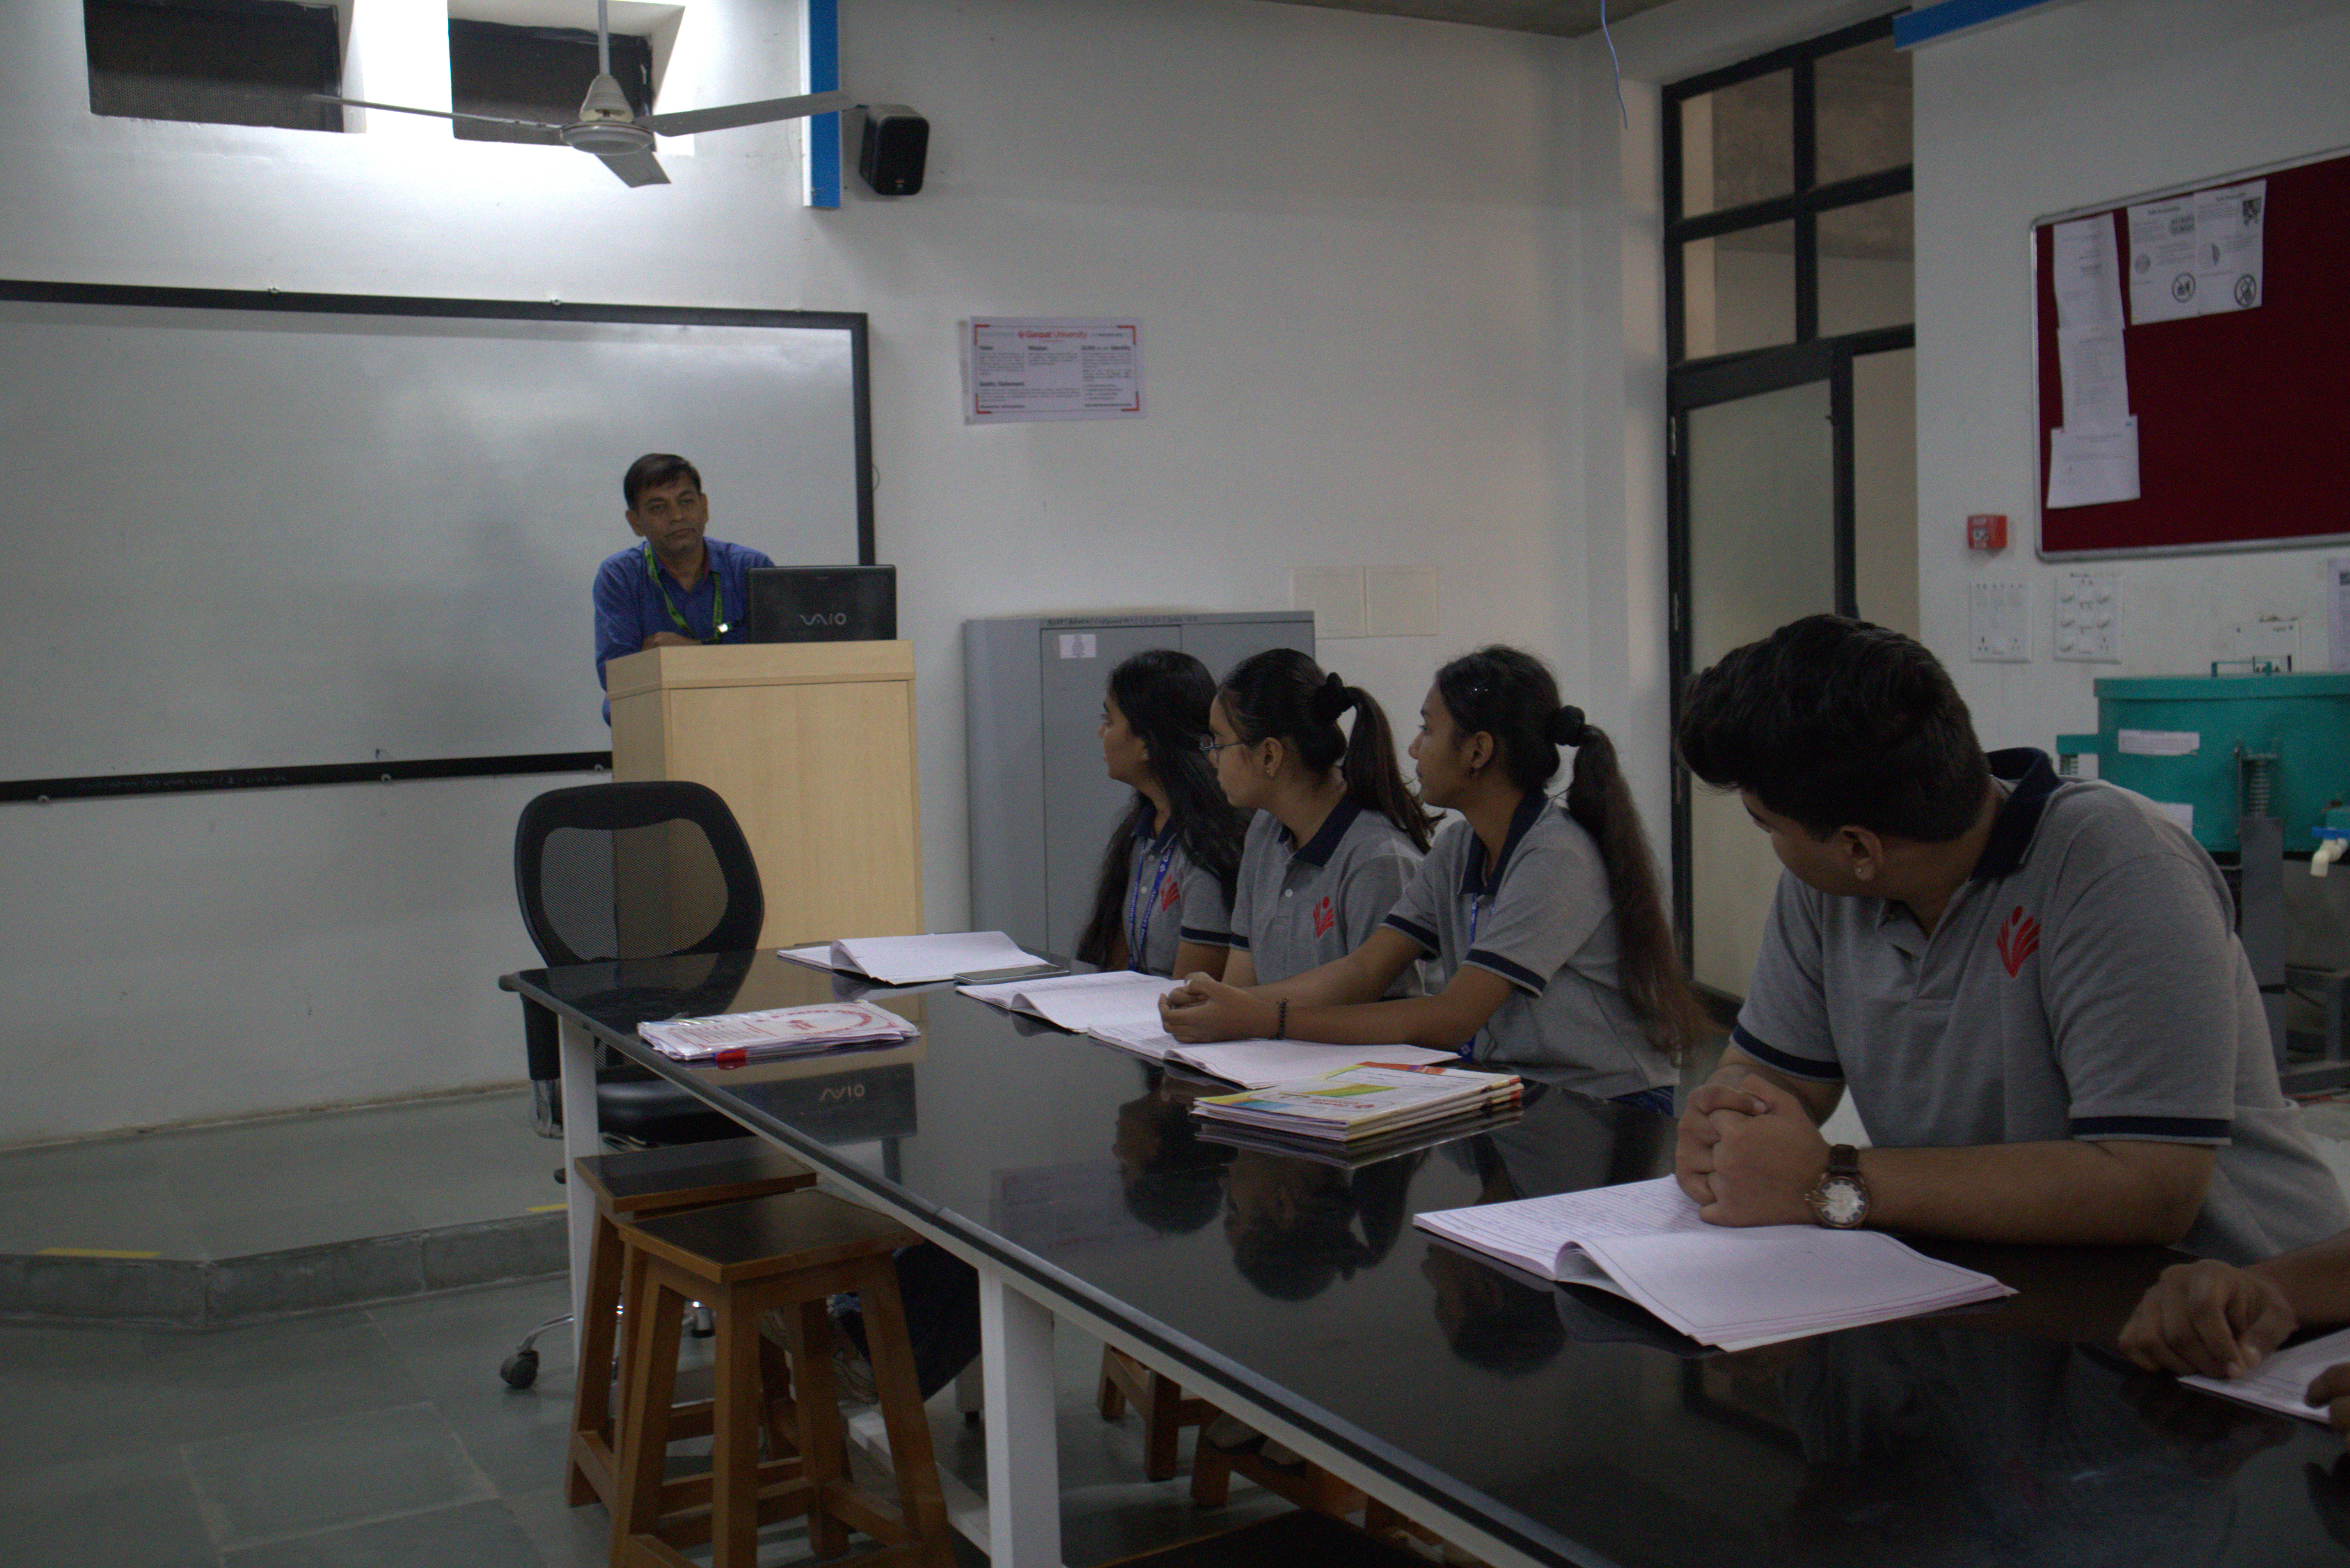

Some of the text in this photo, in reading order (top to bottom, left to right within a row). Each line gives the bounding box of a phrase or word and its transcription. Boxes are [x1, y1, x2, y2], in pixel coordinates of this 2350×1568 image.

[1026, 331, 1088, 339] Ganpat University
[799, 612, 847, 625] VAIO
